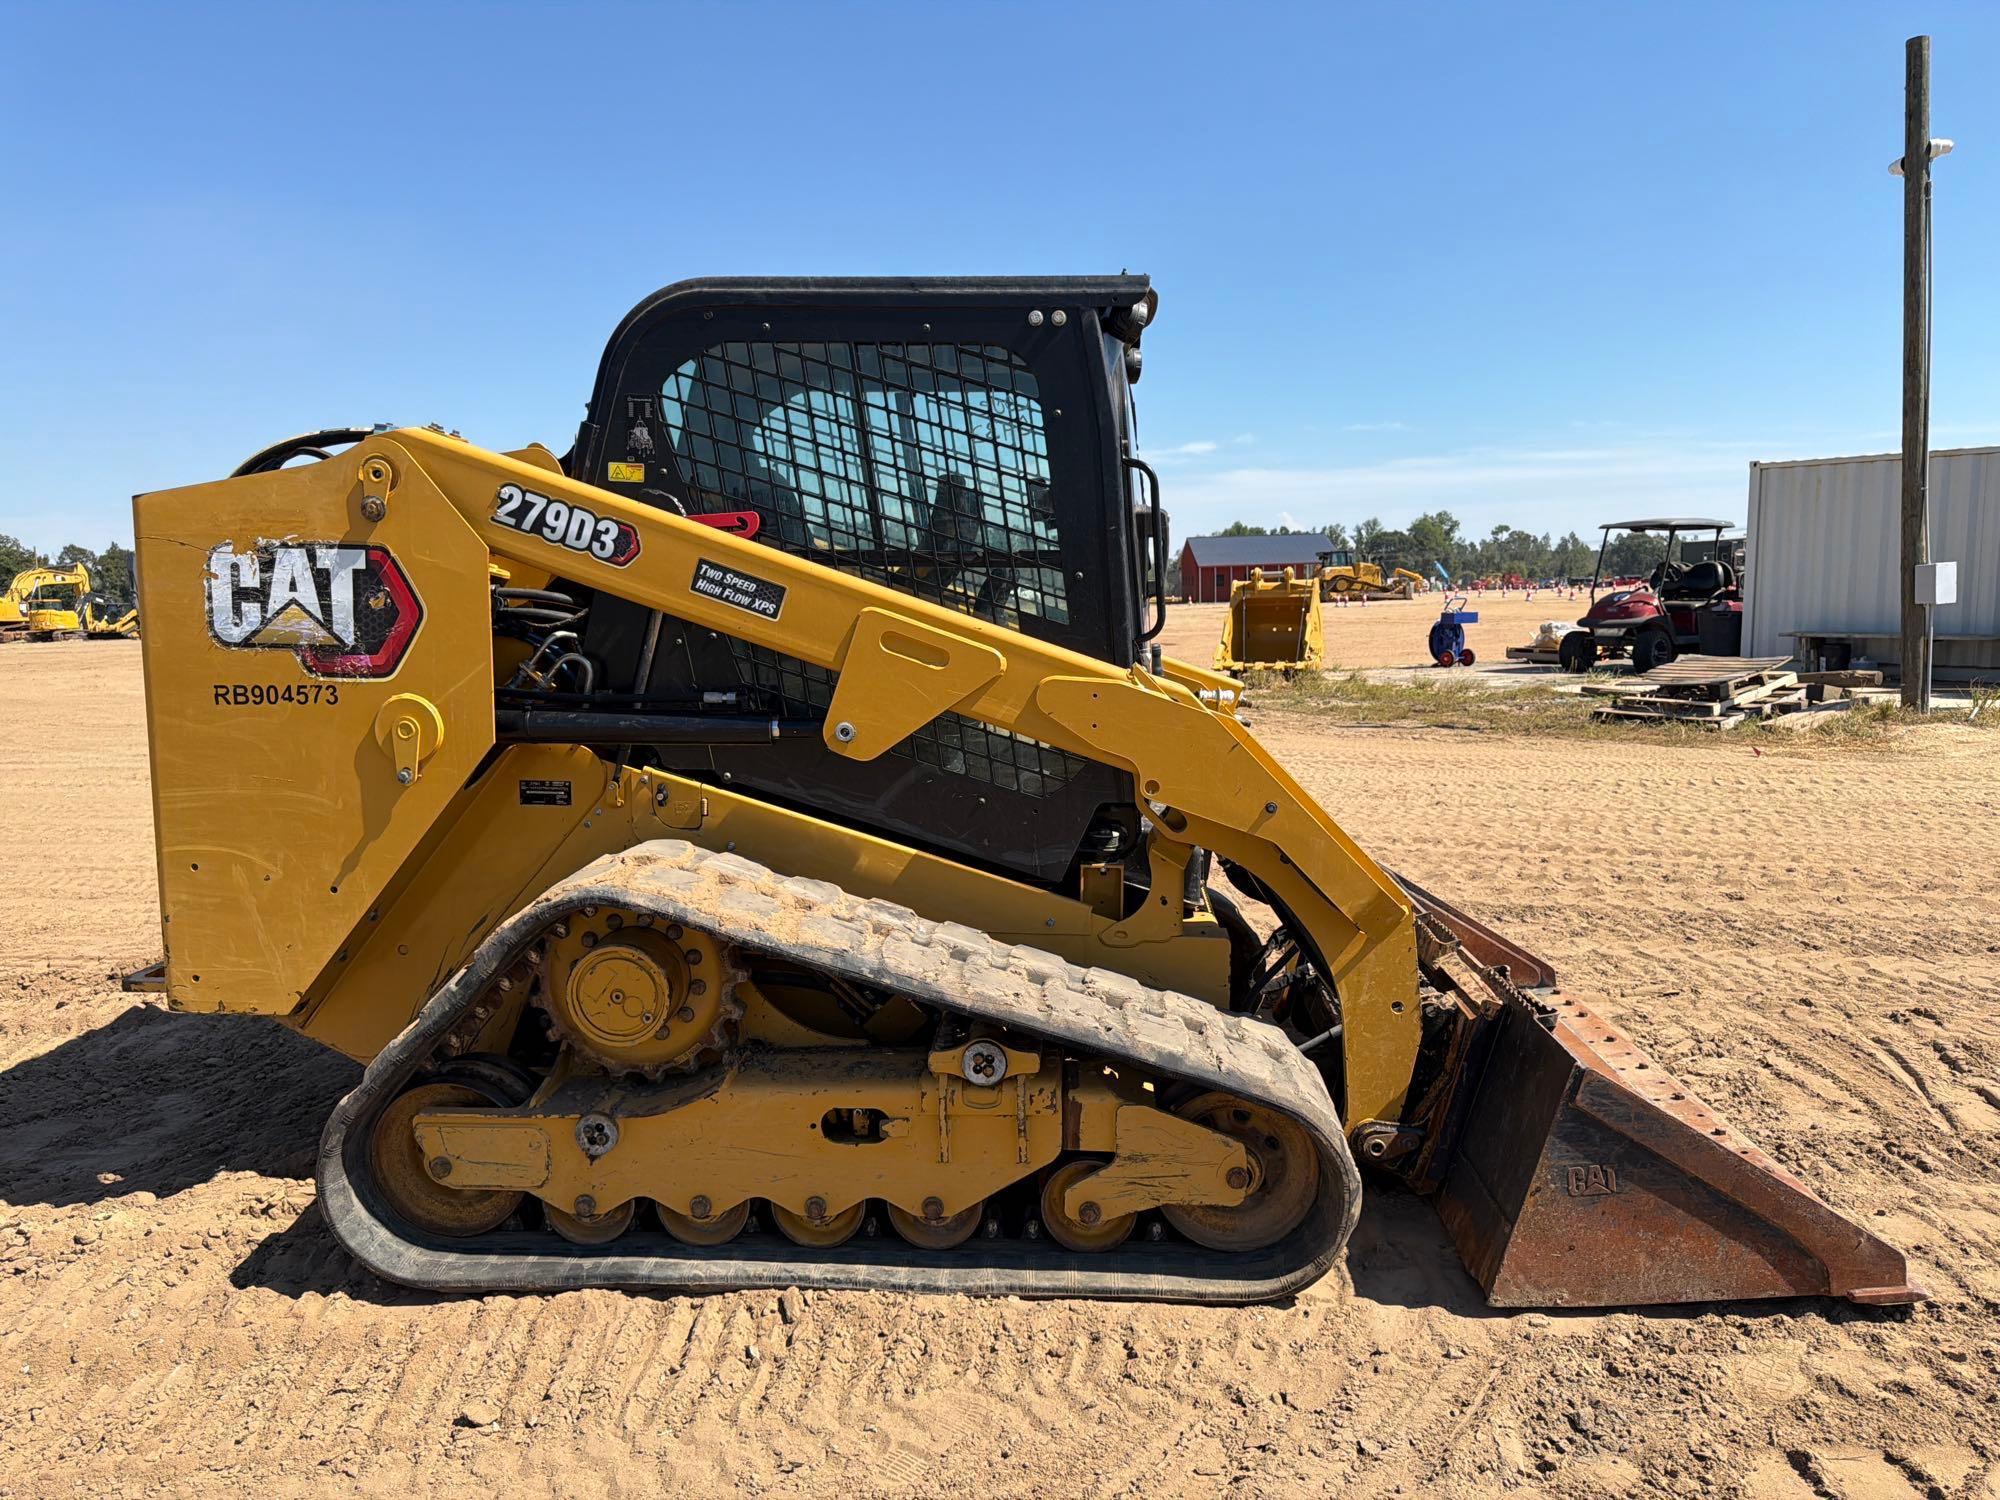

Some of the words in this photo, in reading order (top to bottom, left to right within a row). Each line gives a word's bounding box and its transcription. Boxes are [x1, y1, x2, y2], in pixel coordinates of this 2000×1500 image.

[499, 486, 619, 559] 279D3
[210, 543, 366, 646] CAT
[699, 564, 723, 581] TWO
[724, 573, 757, 593] SPEED
[695, 579, 723, 596] HIGH
[722, 588, 752, 606] FLOW
[751, 598, 777, 614] XPS
[213, 684, 339, 706] RB904573
